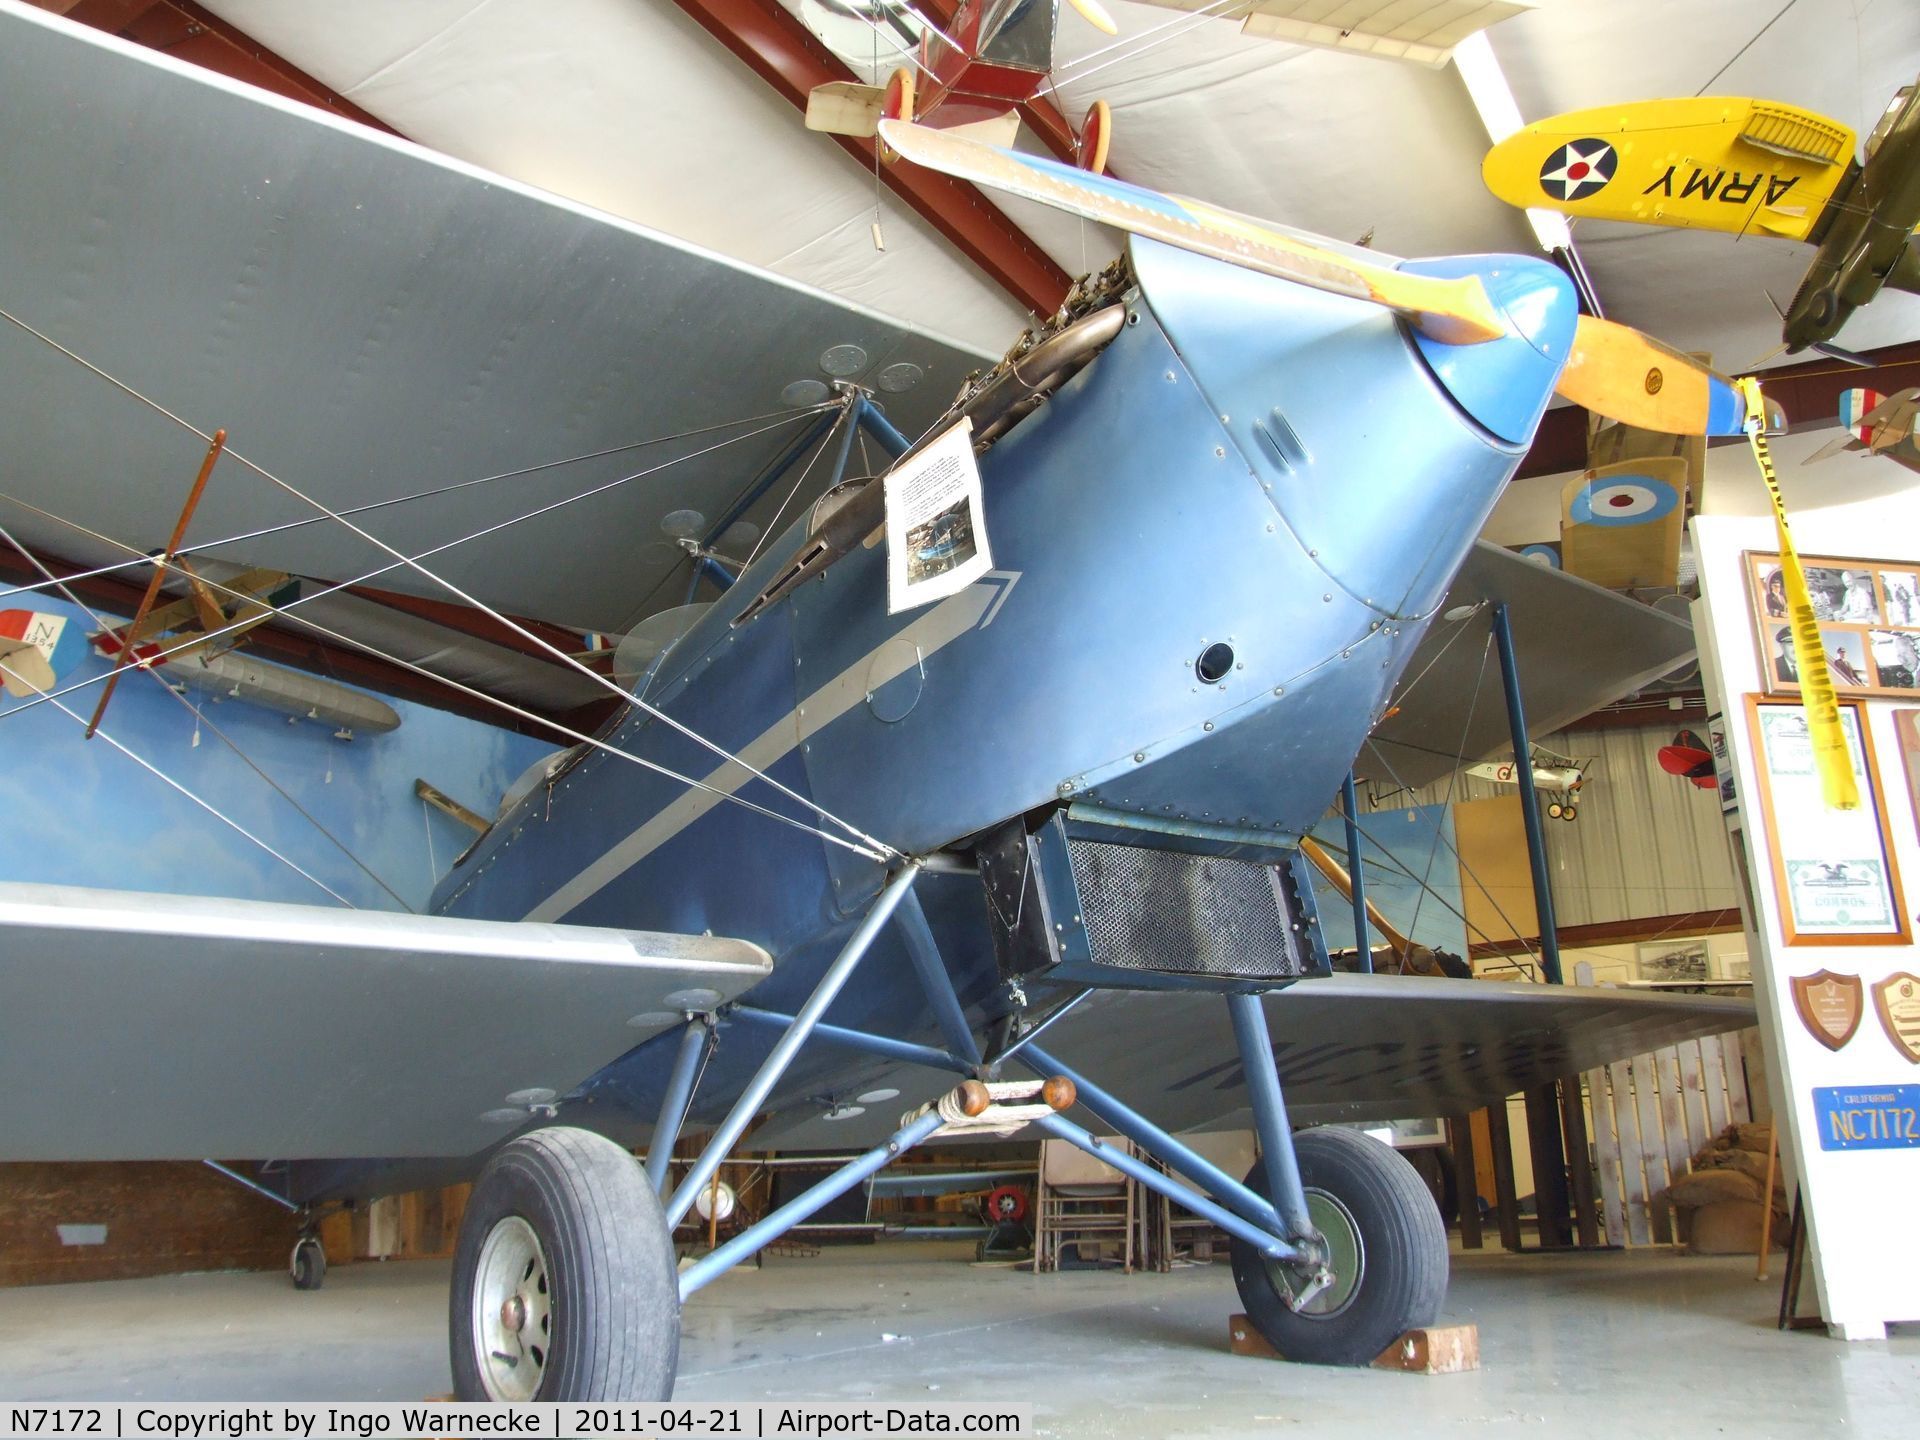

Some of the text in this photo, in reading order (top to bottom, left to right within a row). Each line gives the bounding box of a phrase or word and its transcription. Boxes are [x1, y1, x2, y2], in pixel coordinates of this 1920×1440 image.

[1642, 166, 1800, 207] ARMY
[35, 622, 54, 639] N
[1829, 1107, 1920, 1141] NC7172
